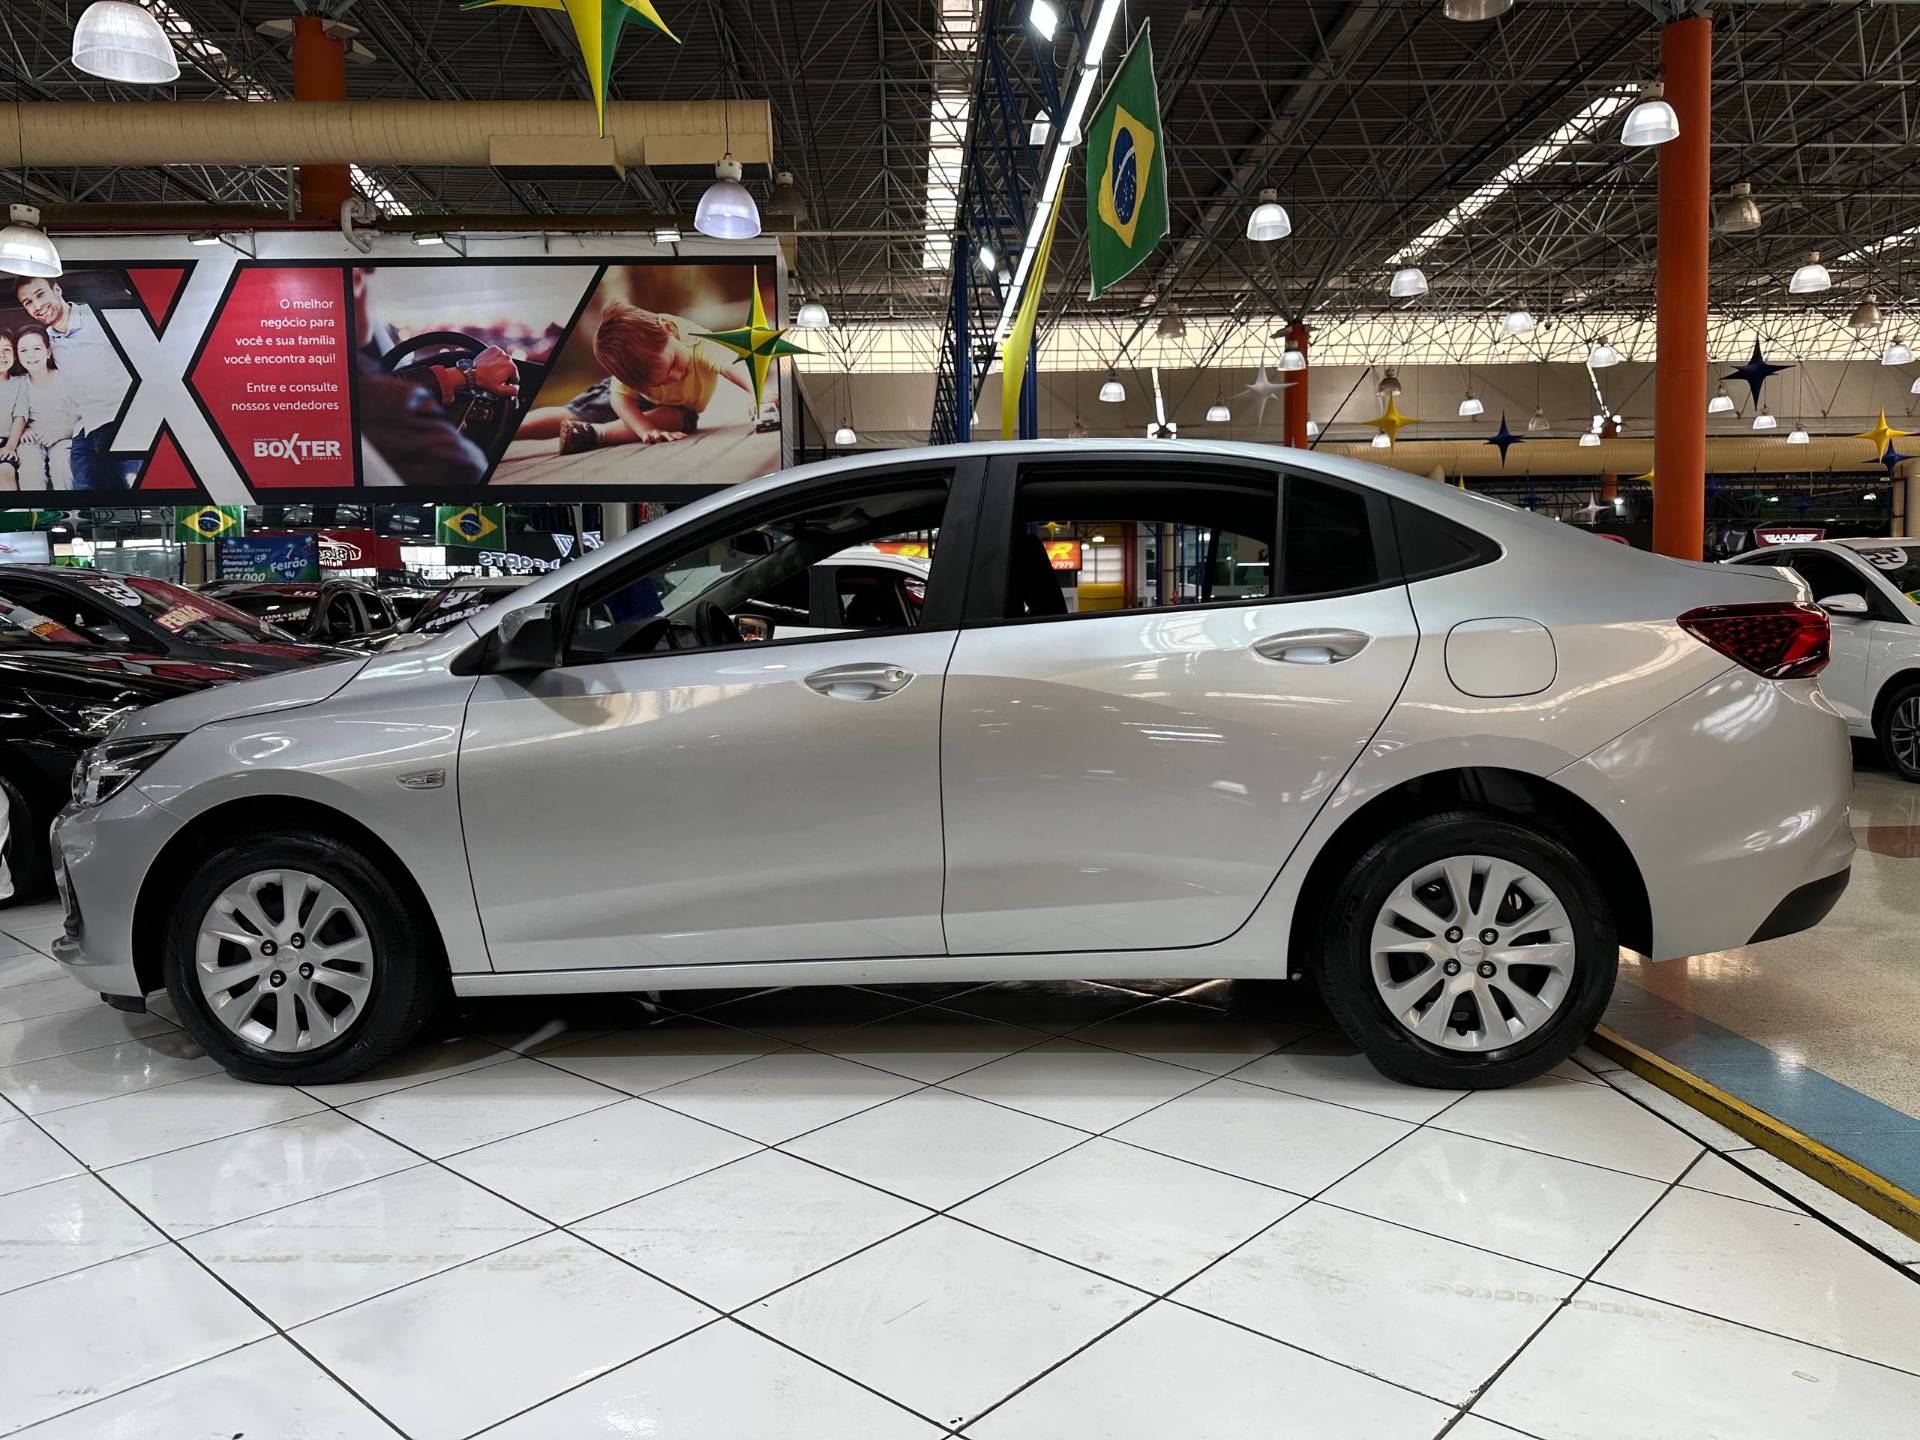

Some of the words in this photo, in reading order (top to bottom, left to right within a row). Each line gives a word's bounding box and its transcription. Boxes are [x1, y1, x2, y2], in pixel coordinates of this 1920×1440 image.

[280, 299, 290, 309] O
[293, 299, 334, 309] melhor
[260, 318, 307, 330] negócio
[310, 319, 335, 329] para
[235, 336, 263, 346] você
[266, 338, 273, 346] e
[275, 338, 295, 346] sua
[298, 335, 336, 346] família
[224, 355, 251, 365] você
[254, 354, 306, 364] encontra
[308, 353, 336, 366] aqui!
[247, 383, 277, 393] Entre
[280, 384, 286, 393] e
[289, 383, 338, 393] consulte
[231, 402, 270, 411] nossos
[273, 401, 339, 411] vendedores
[254, 433, 342, 464] BOXTER
[271, 557, 308, 573] Feirão
